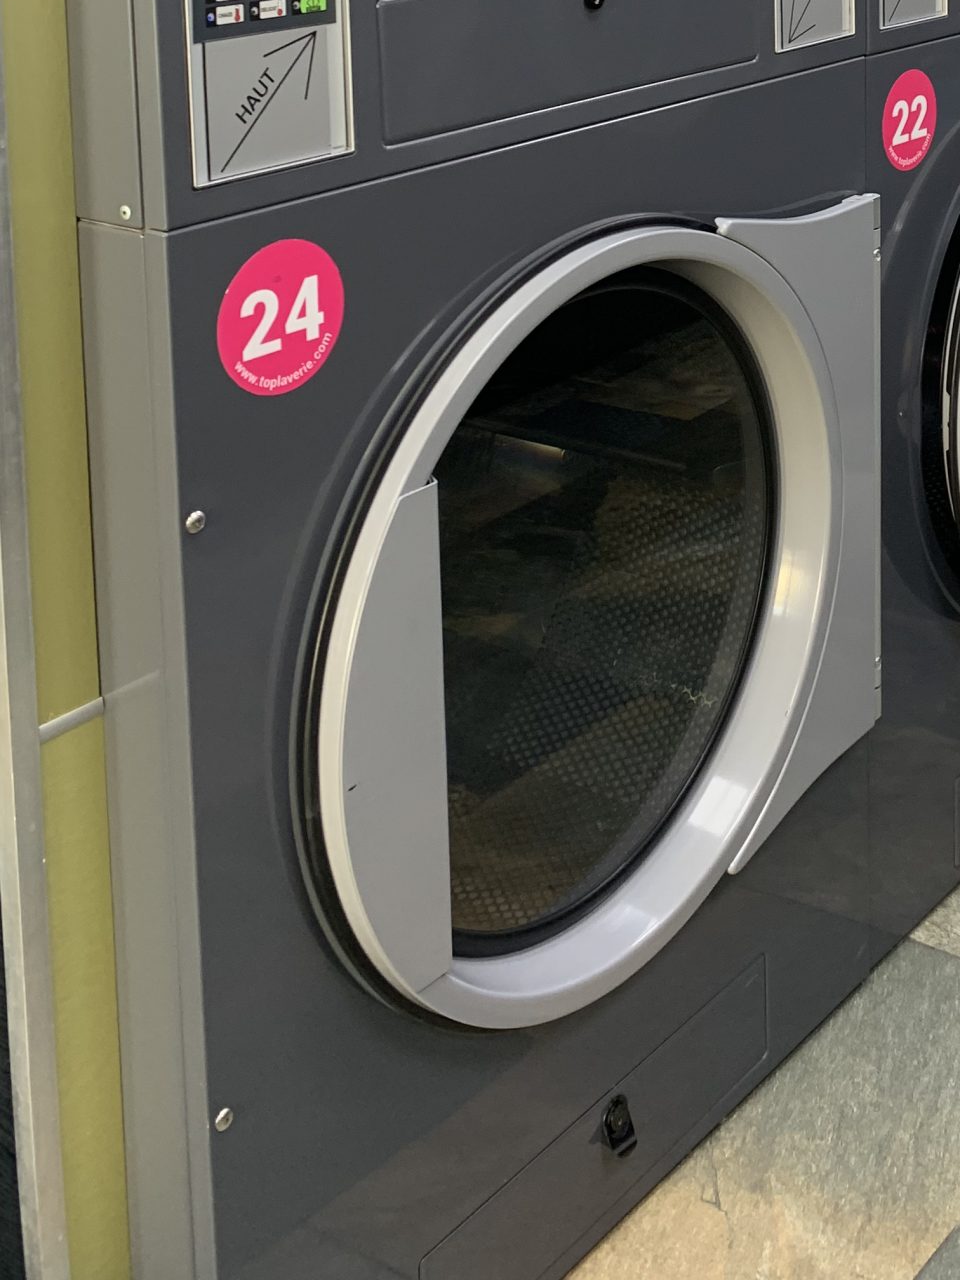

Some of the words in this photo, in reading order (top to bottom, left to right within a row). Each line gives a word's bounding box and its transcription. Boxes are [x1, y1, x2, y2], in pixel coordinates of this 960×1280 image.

[235, 67, 276, 125] HAUT
[892, 94, 928, 147] 22
[240, 274, 325, 362] 24
[234, 331, 333, 391] www.toplaverie.com
